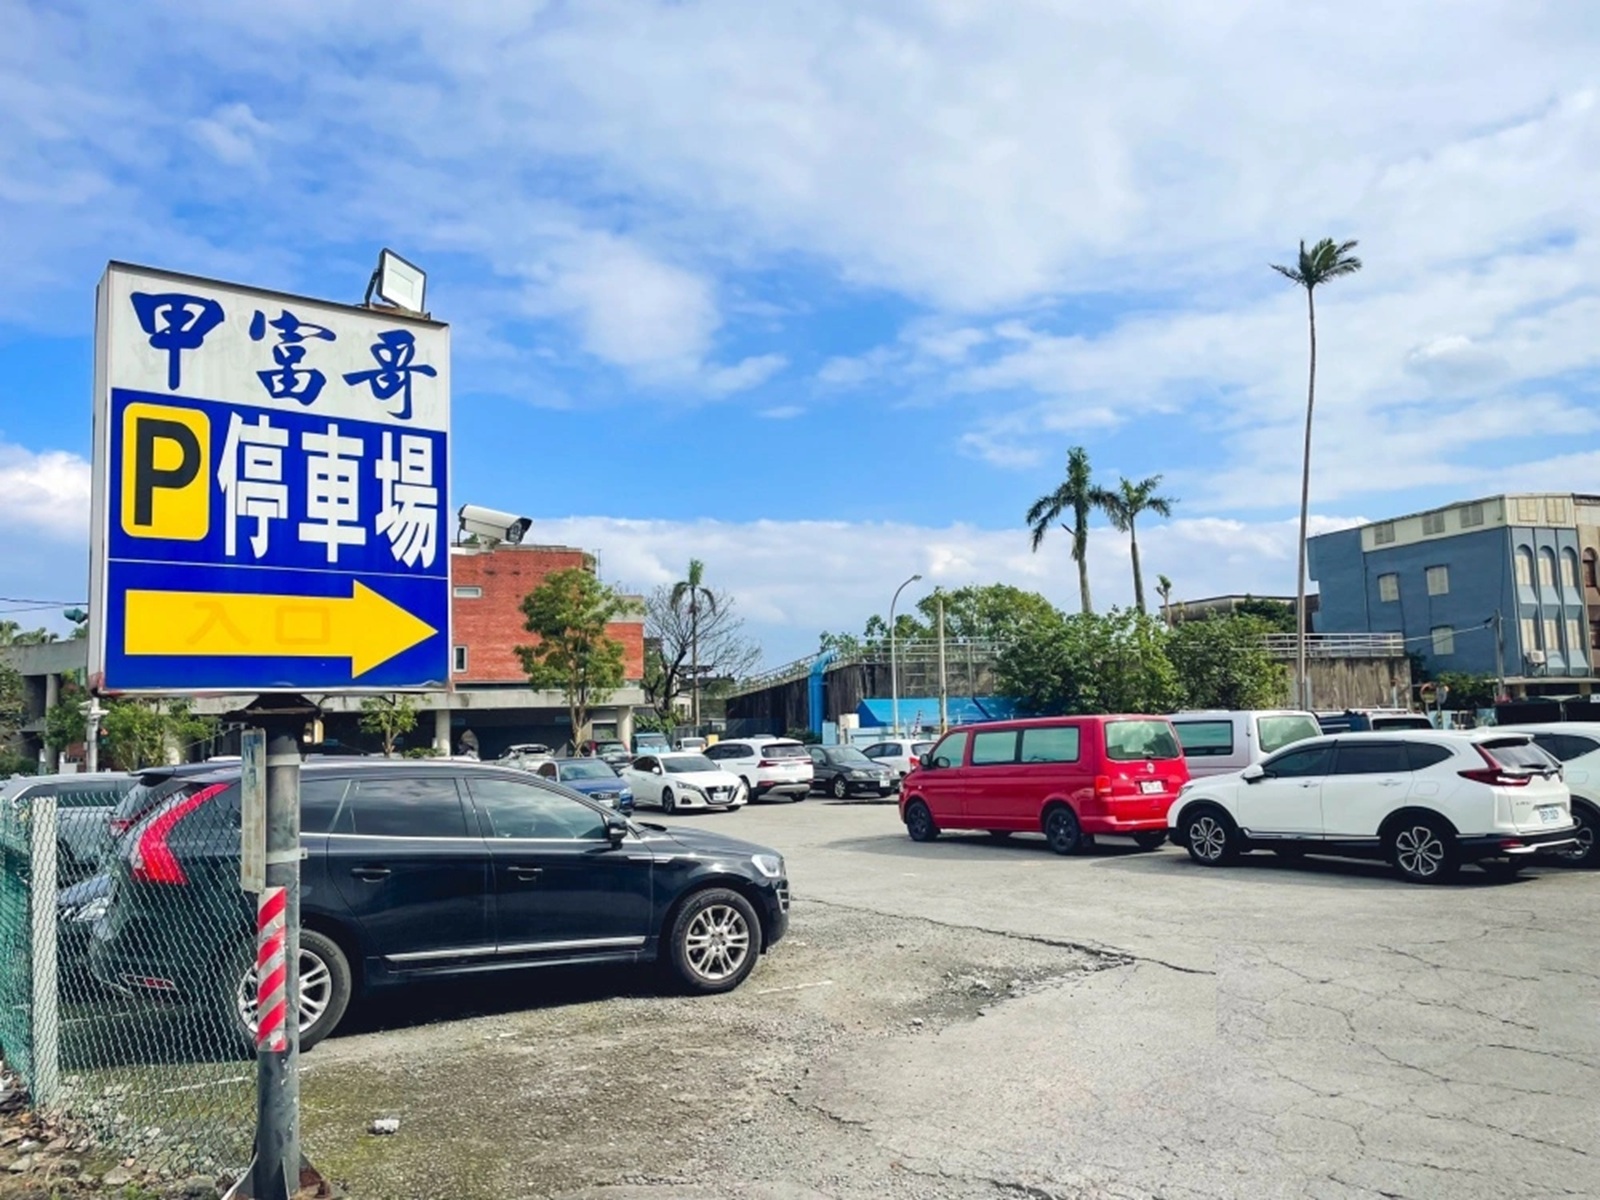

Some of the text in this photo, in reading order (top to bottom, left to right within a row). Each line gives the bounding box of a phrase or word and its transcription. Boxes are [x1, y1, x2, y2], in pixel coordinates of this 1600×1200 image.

[130, 291, 437, 419] 甲富哥
[133, 411, 438, 569] P 停車場
[187, 600, 330, 646] 入口
